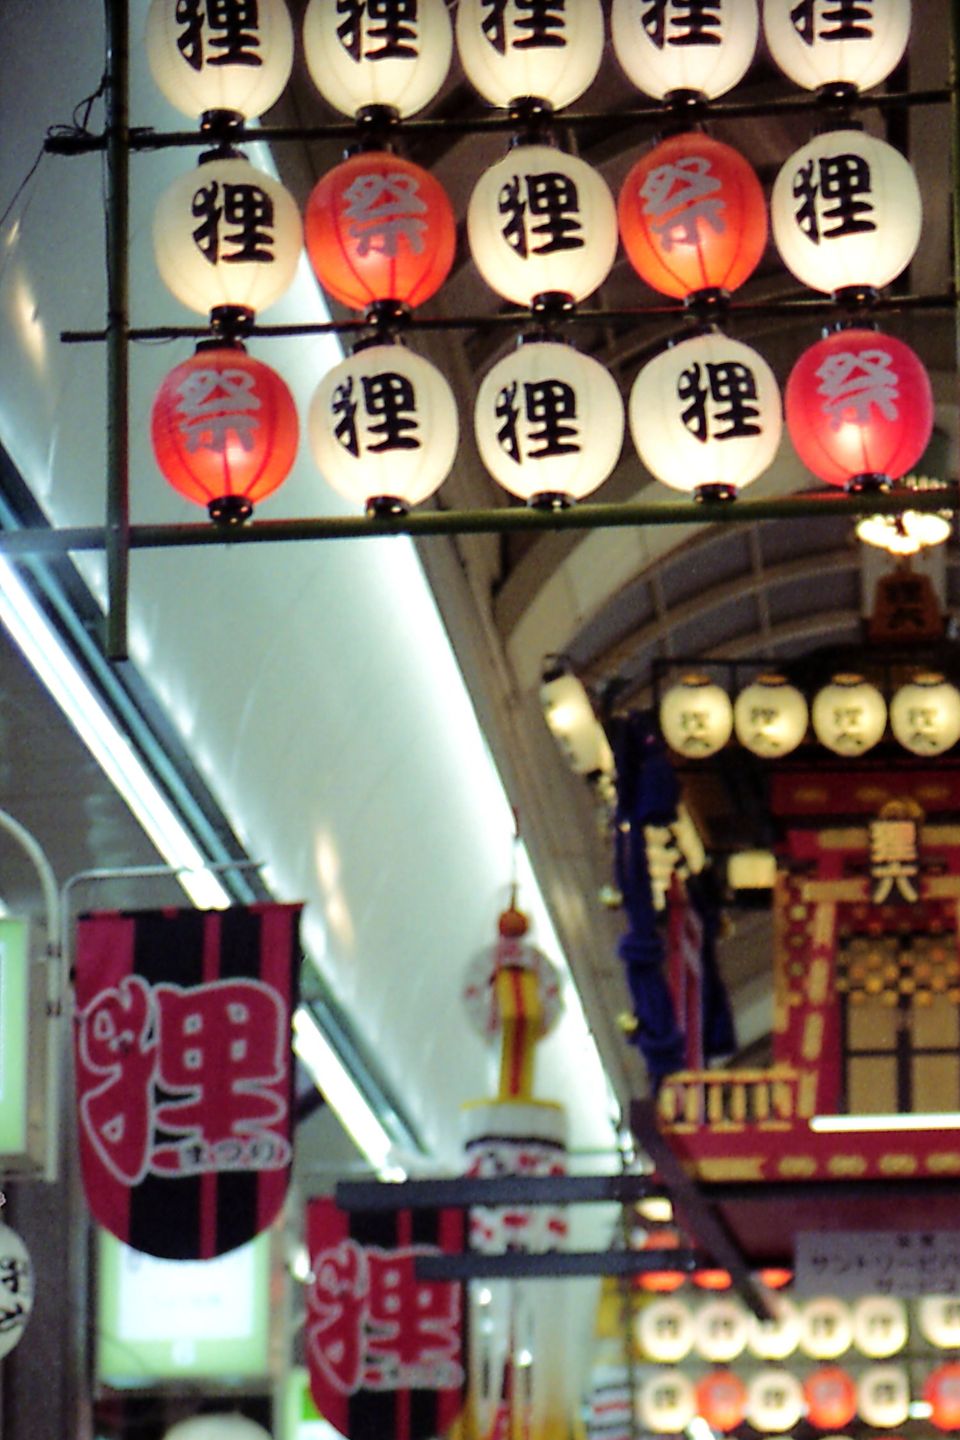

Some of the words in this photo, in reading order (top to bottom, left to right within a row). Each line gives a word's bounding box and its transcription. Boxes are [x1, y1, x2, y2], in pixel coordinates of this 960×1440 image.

[175, 0, 263, 71] 狸
[336, 0, 418, 62] 狸
[191, 180, 276, 265] 狸
[346, 173, 428, 258] 祭
[498, 172, 584, 257] 狸
[640, 157, 725, 251] 祭
[792, 154, 877, 242] 狸
[177, 369, 262, 455] 祭
[332, 372, 420, 457] 狸
[495, 380, 581, 465] 狸
[678, 360, 761, 442] 狸
[815, 348, 899, 424] 祭
